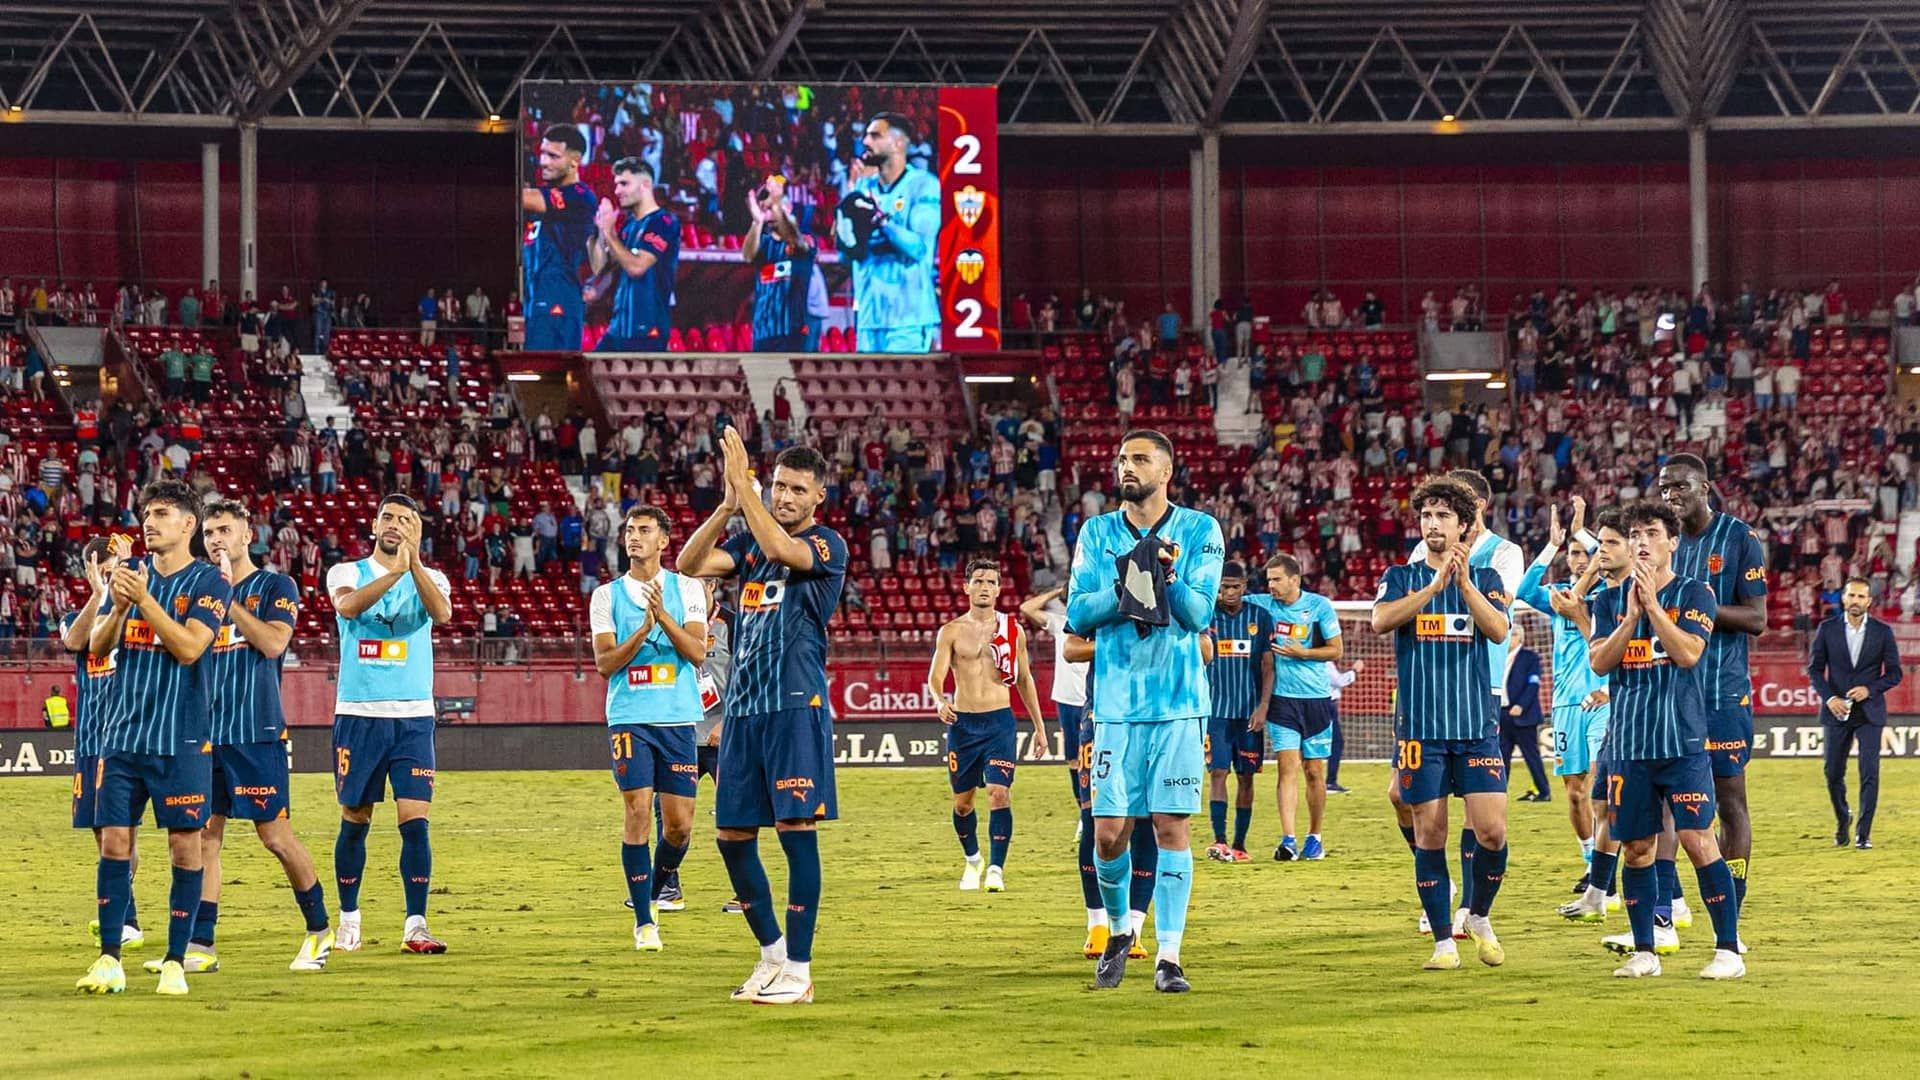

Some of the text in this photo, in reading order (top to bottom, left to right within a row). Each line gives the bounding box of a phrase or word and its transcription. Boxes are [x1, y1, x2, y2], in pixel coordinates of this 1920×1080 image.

[953, 136, 982, 174] 2
[955, 298, 984, 337] 2
[744, 588, 759, 602] TM
[130, 625, 150, 639] TM
[1421, 619, 1440, 632] TM
[361, 644, 378, 656] TM
[1626, 646, 1645, 658] TM
[88, 657, 105, 669] TM
[631, 669, 648, 682] TM
[612, 732, 632, 760] 31
[909, 740, 939, 756] DE
[1552, 731, 1567, 752] 13
[335, 747, 350, 777] 15
[1396, 740, 1422, 770] 30
[775, 777, 815, 790] SKODA
[234, 786, 278, 796] SKODA
[164, 794, 206, 806] SKODA
